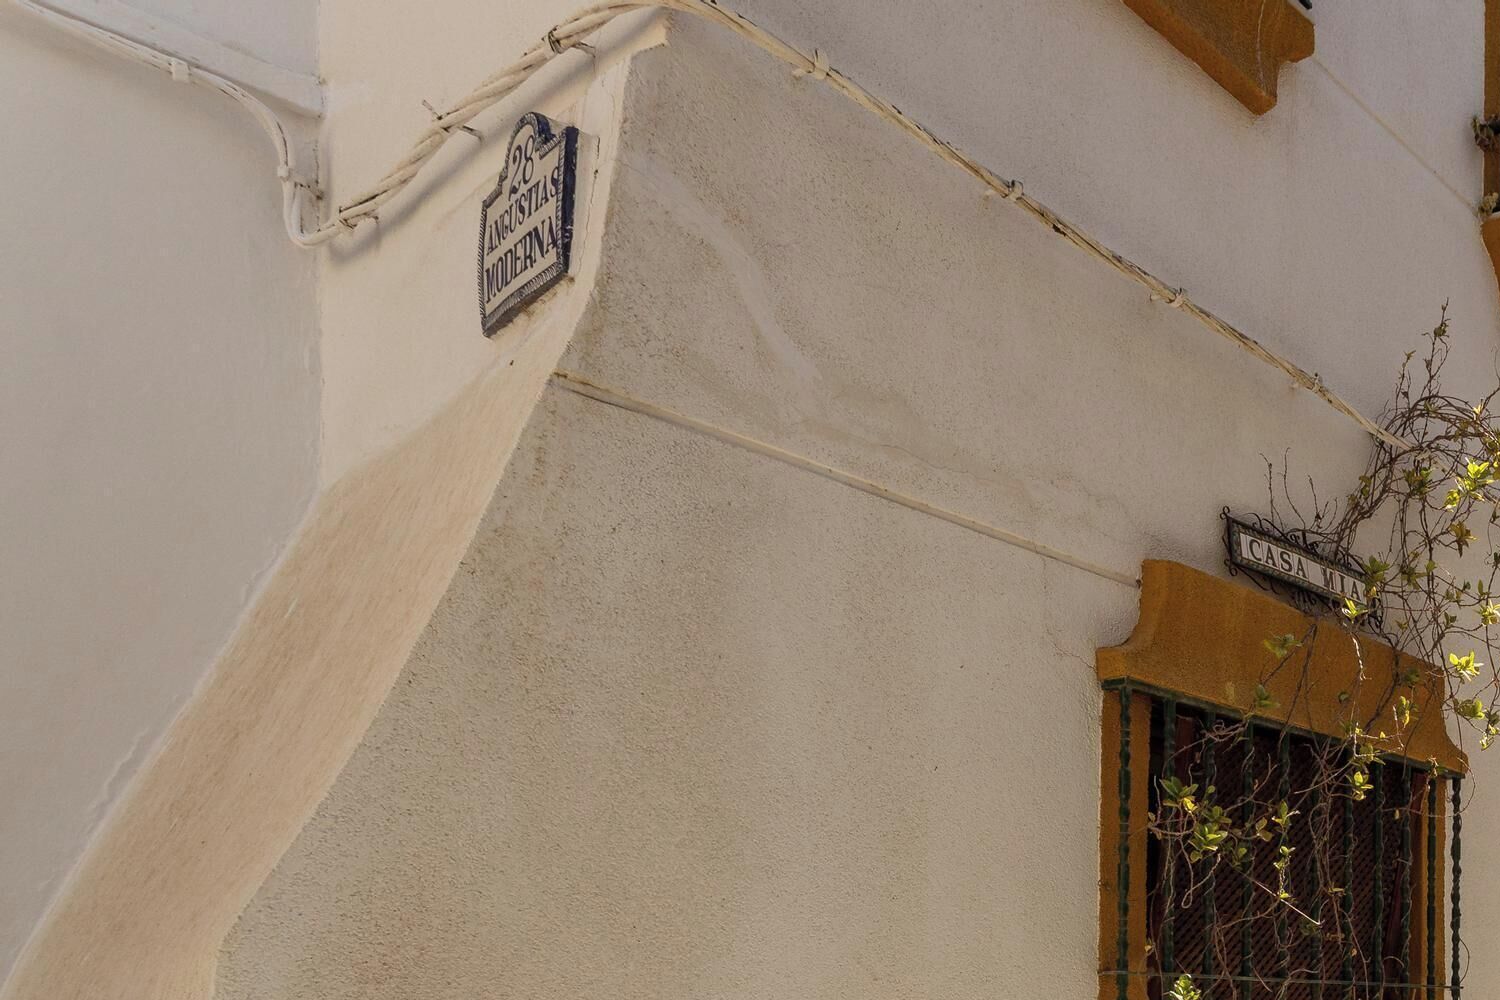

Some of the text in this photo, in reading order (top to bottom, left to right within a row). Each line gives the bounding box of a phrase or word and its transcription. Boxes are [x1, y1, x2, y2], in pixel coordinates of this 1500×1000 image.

[508, 135, 535, 201] 28
[486, 165, 560, 256] ANGUSTIAS
[485, 215, 558, 304] MODERNA
[1249, 539, 1361, 601] CASA MIA
